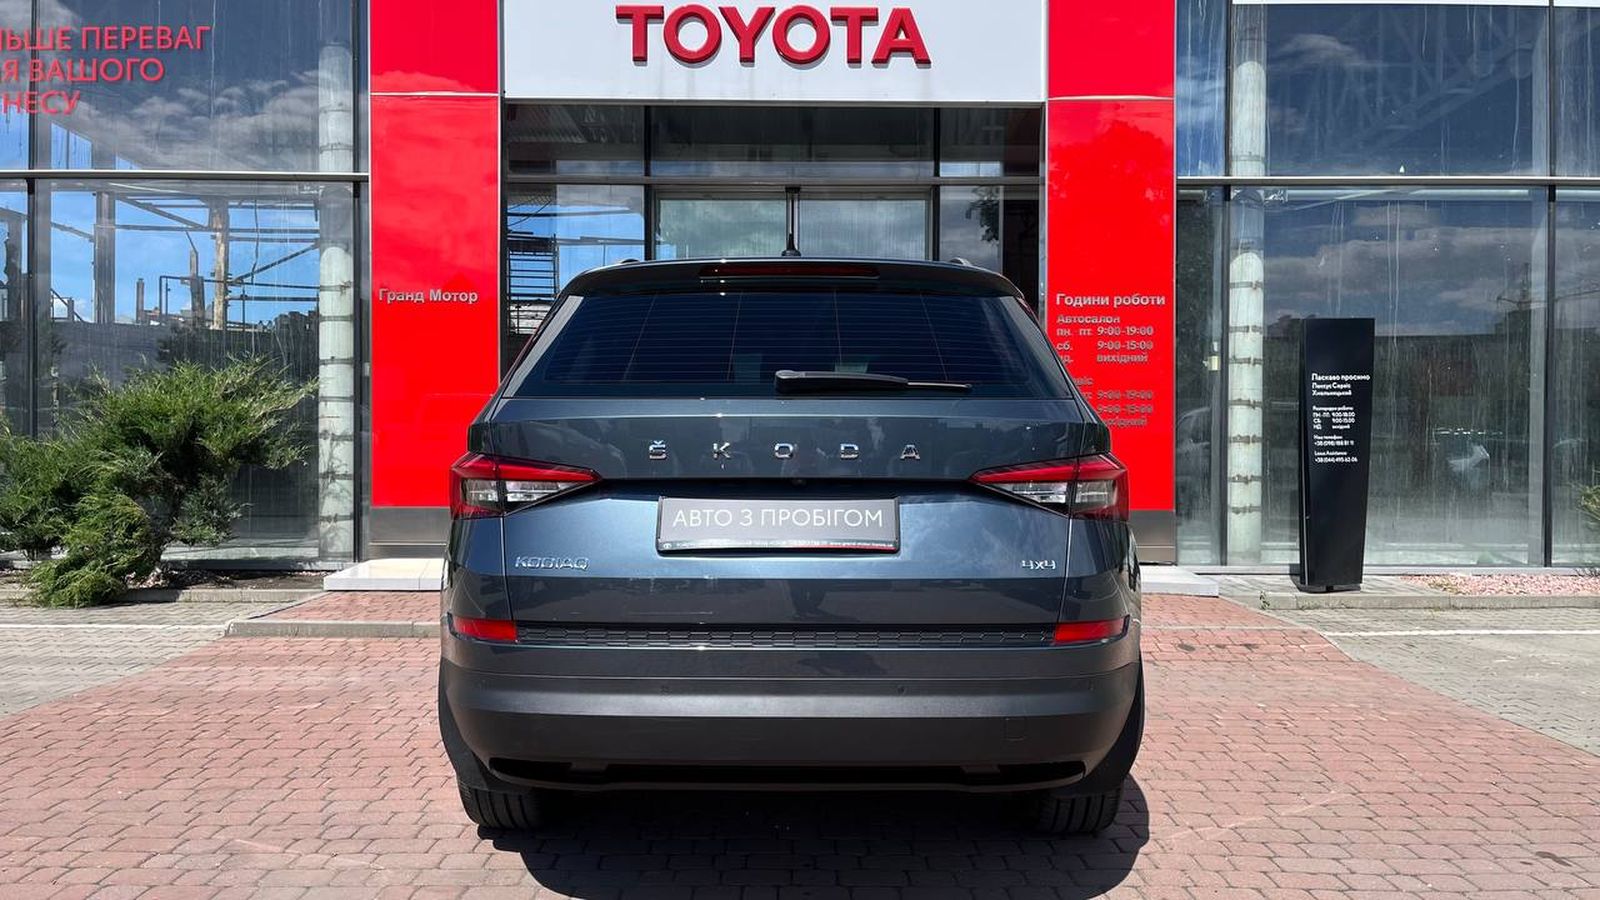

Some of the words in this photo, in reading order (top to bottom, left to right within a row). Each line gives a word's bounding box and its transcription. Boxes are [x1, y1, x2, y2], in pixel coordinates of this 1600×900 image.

[0, 26, 72, 51] ЬШЕ
[81, 26, 211, 51] ПЕРЕВАГ
[615, 4, 931, 66] TOYOTA
[29, 57, 165, 83] ВАШОГО
[379, 288, 425, 304] Гранд
[429, 288, 478, 304] Мотор
[1056, 293, 1110, 308] Години
[1113, 294, 1166, 308] роботи
[1056, 314, 1121, 324] Автосалон
[1096, 352, 1148, 364] вихідний
[649, 440, 921, 460] ŠKODA
[672, 509, 733, 527] АВТО
[760, 509, 883, 527] ПРОБІГОМ
[514, 556, 589, 570] KODIAQ
